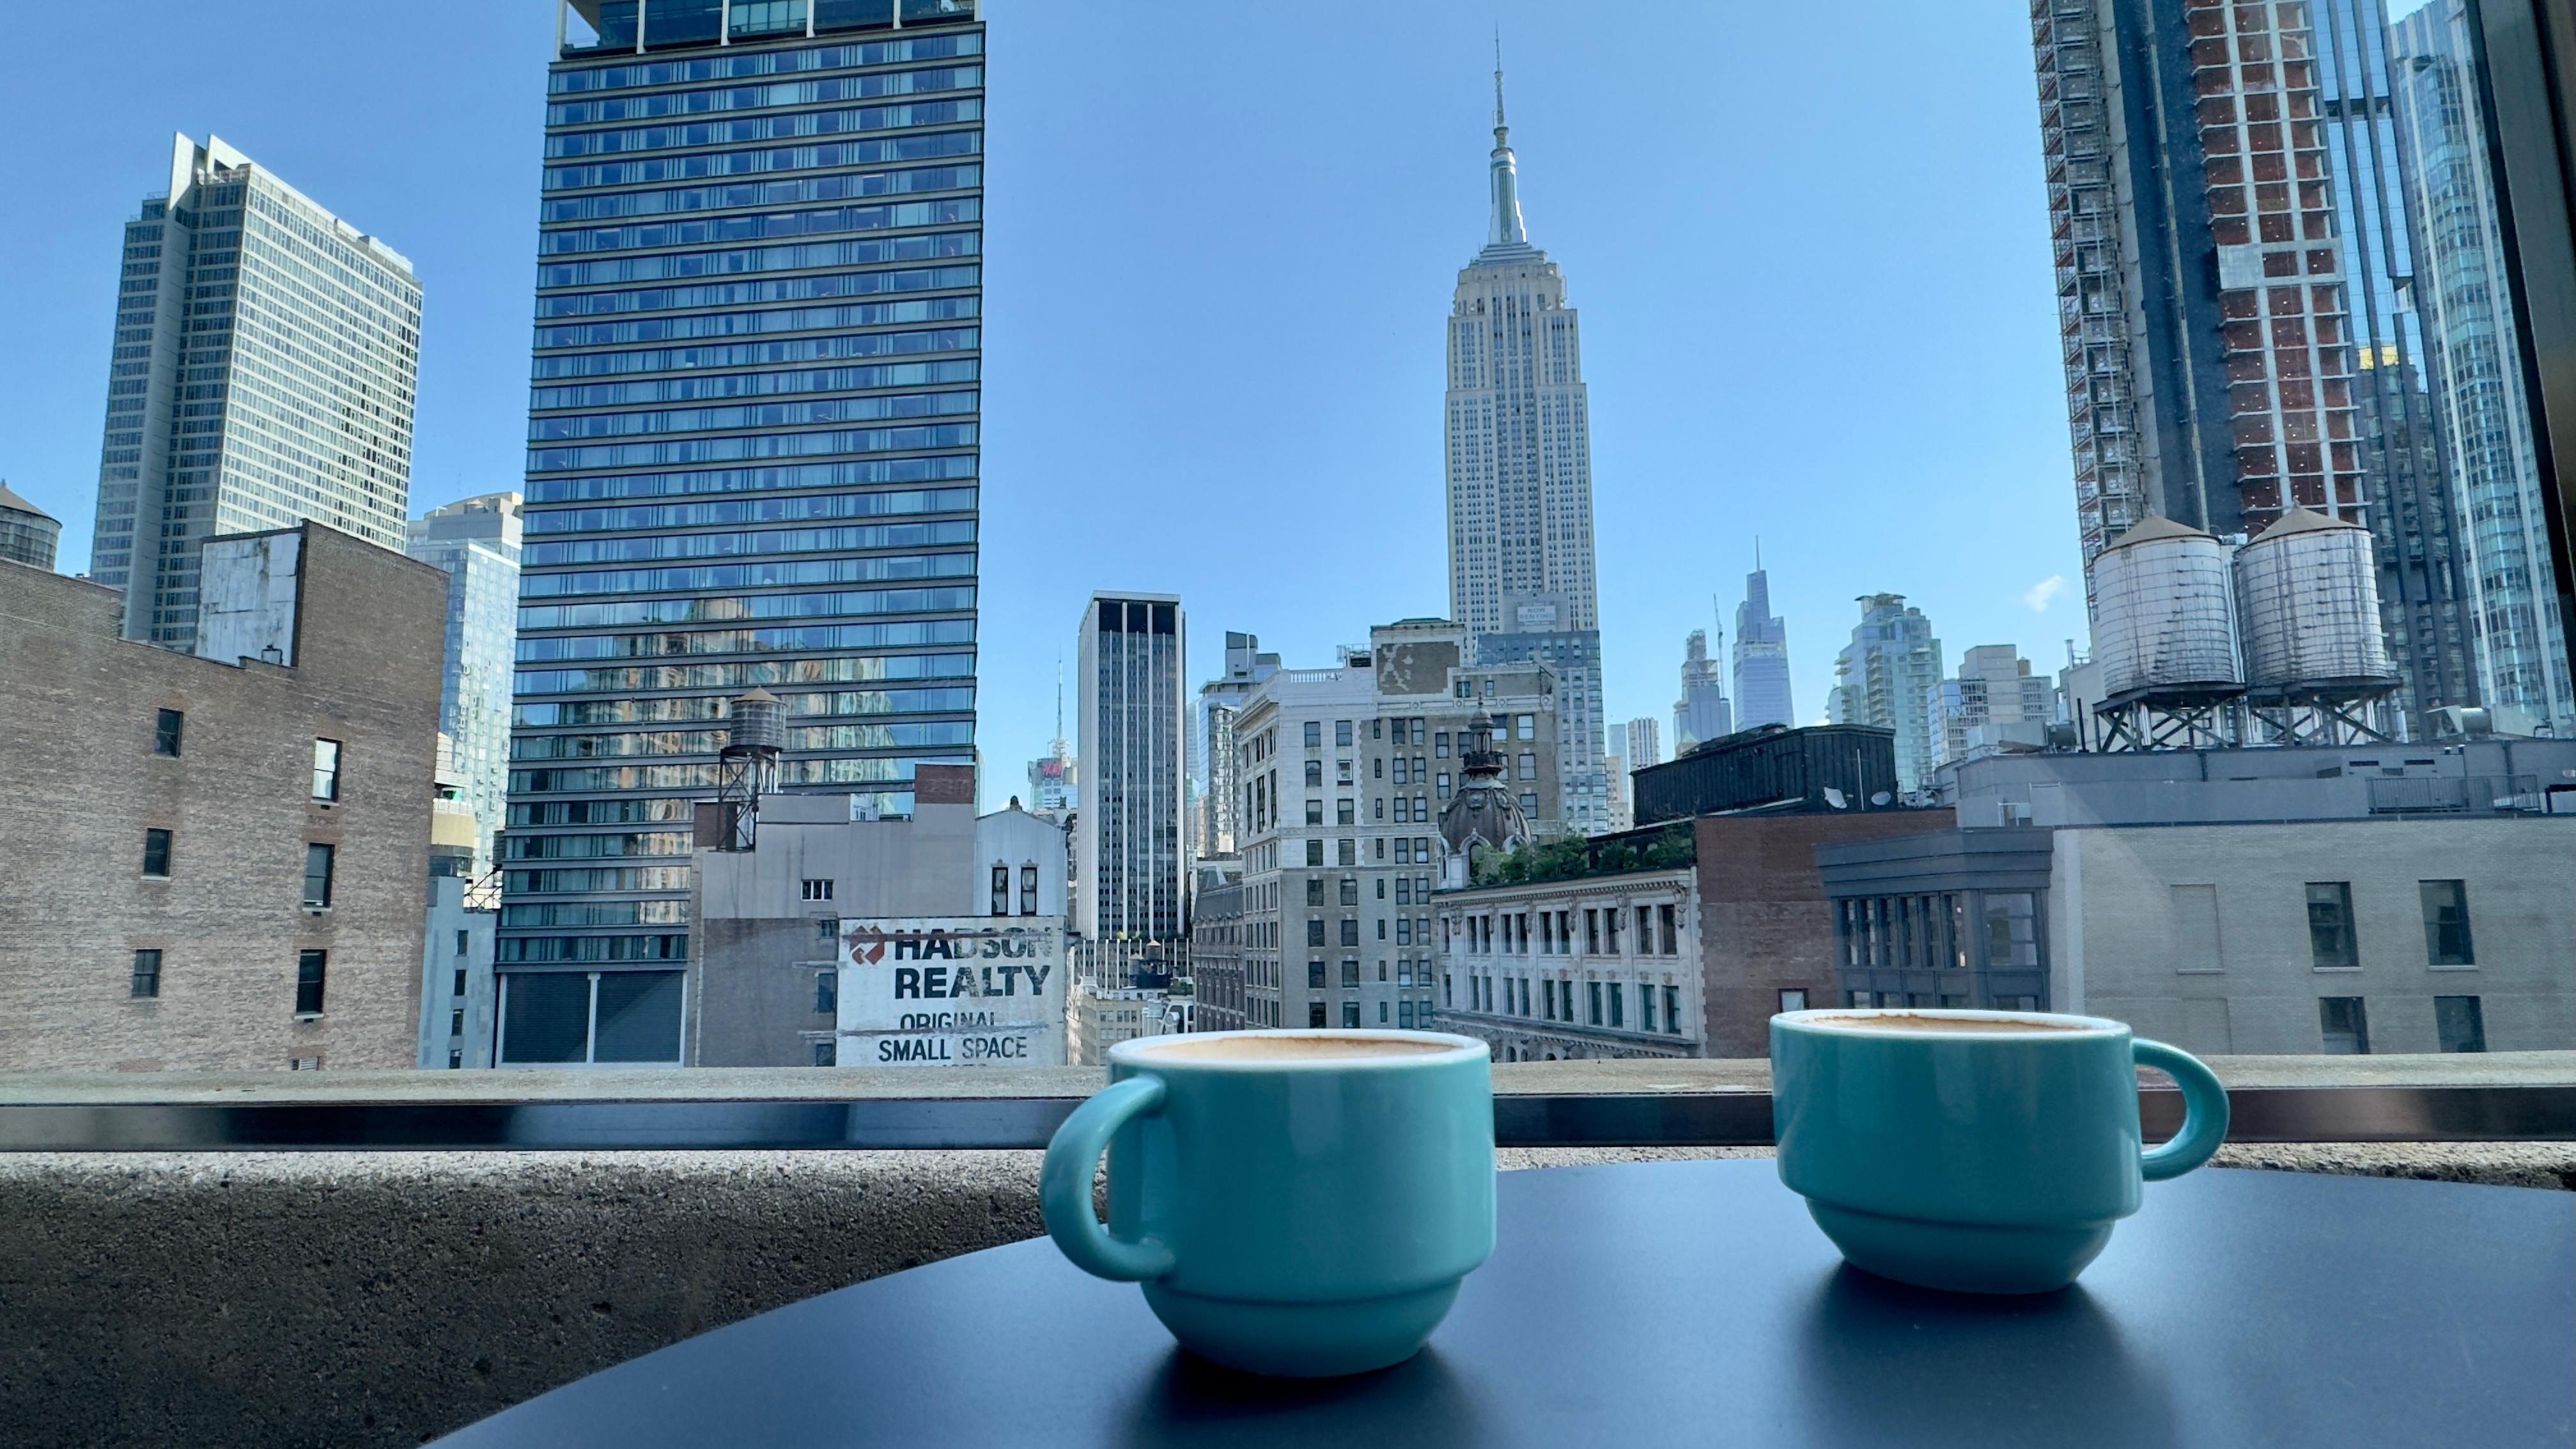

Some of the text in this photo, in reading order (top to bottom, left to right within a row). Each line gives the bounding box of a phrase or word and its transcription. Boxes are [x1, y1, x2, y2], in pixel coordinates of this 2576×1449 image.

[895, 965, 1051, 999] REALTY
[900, 1012, 995, 1030] ORIGINAL
[878, 1036, 1027, 1062] SMALL SPACE
